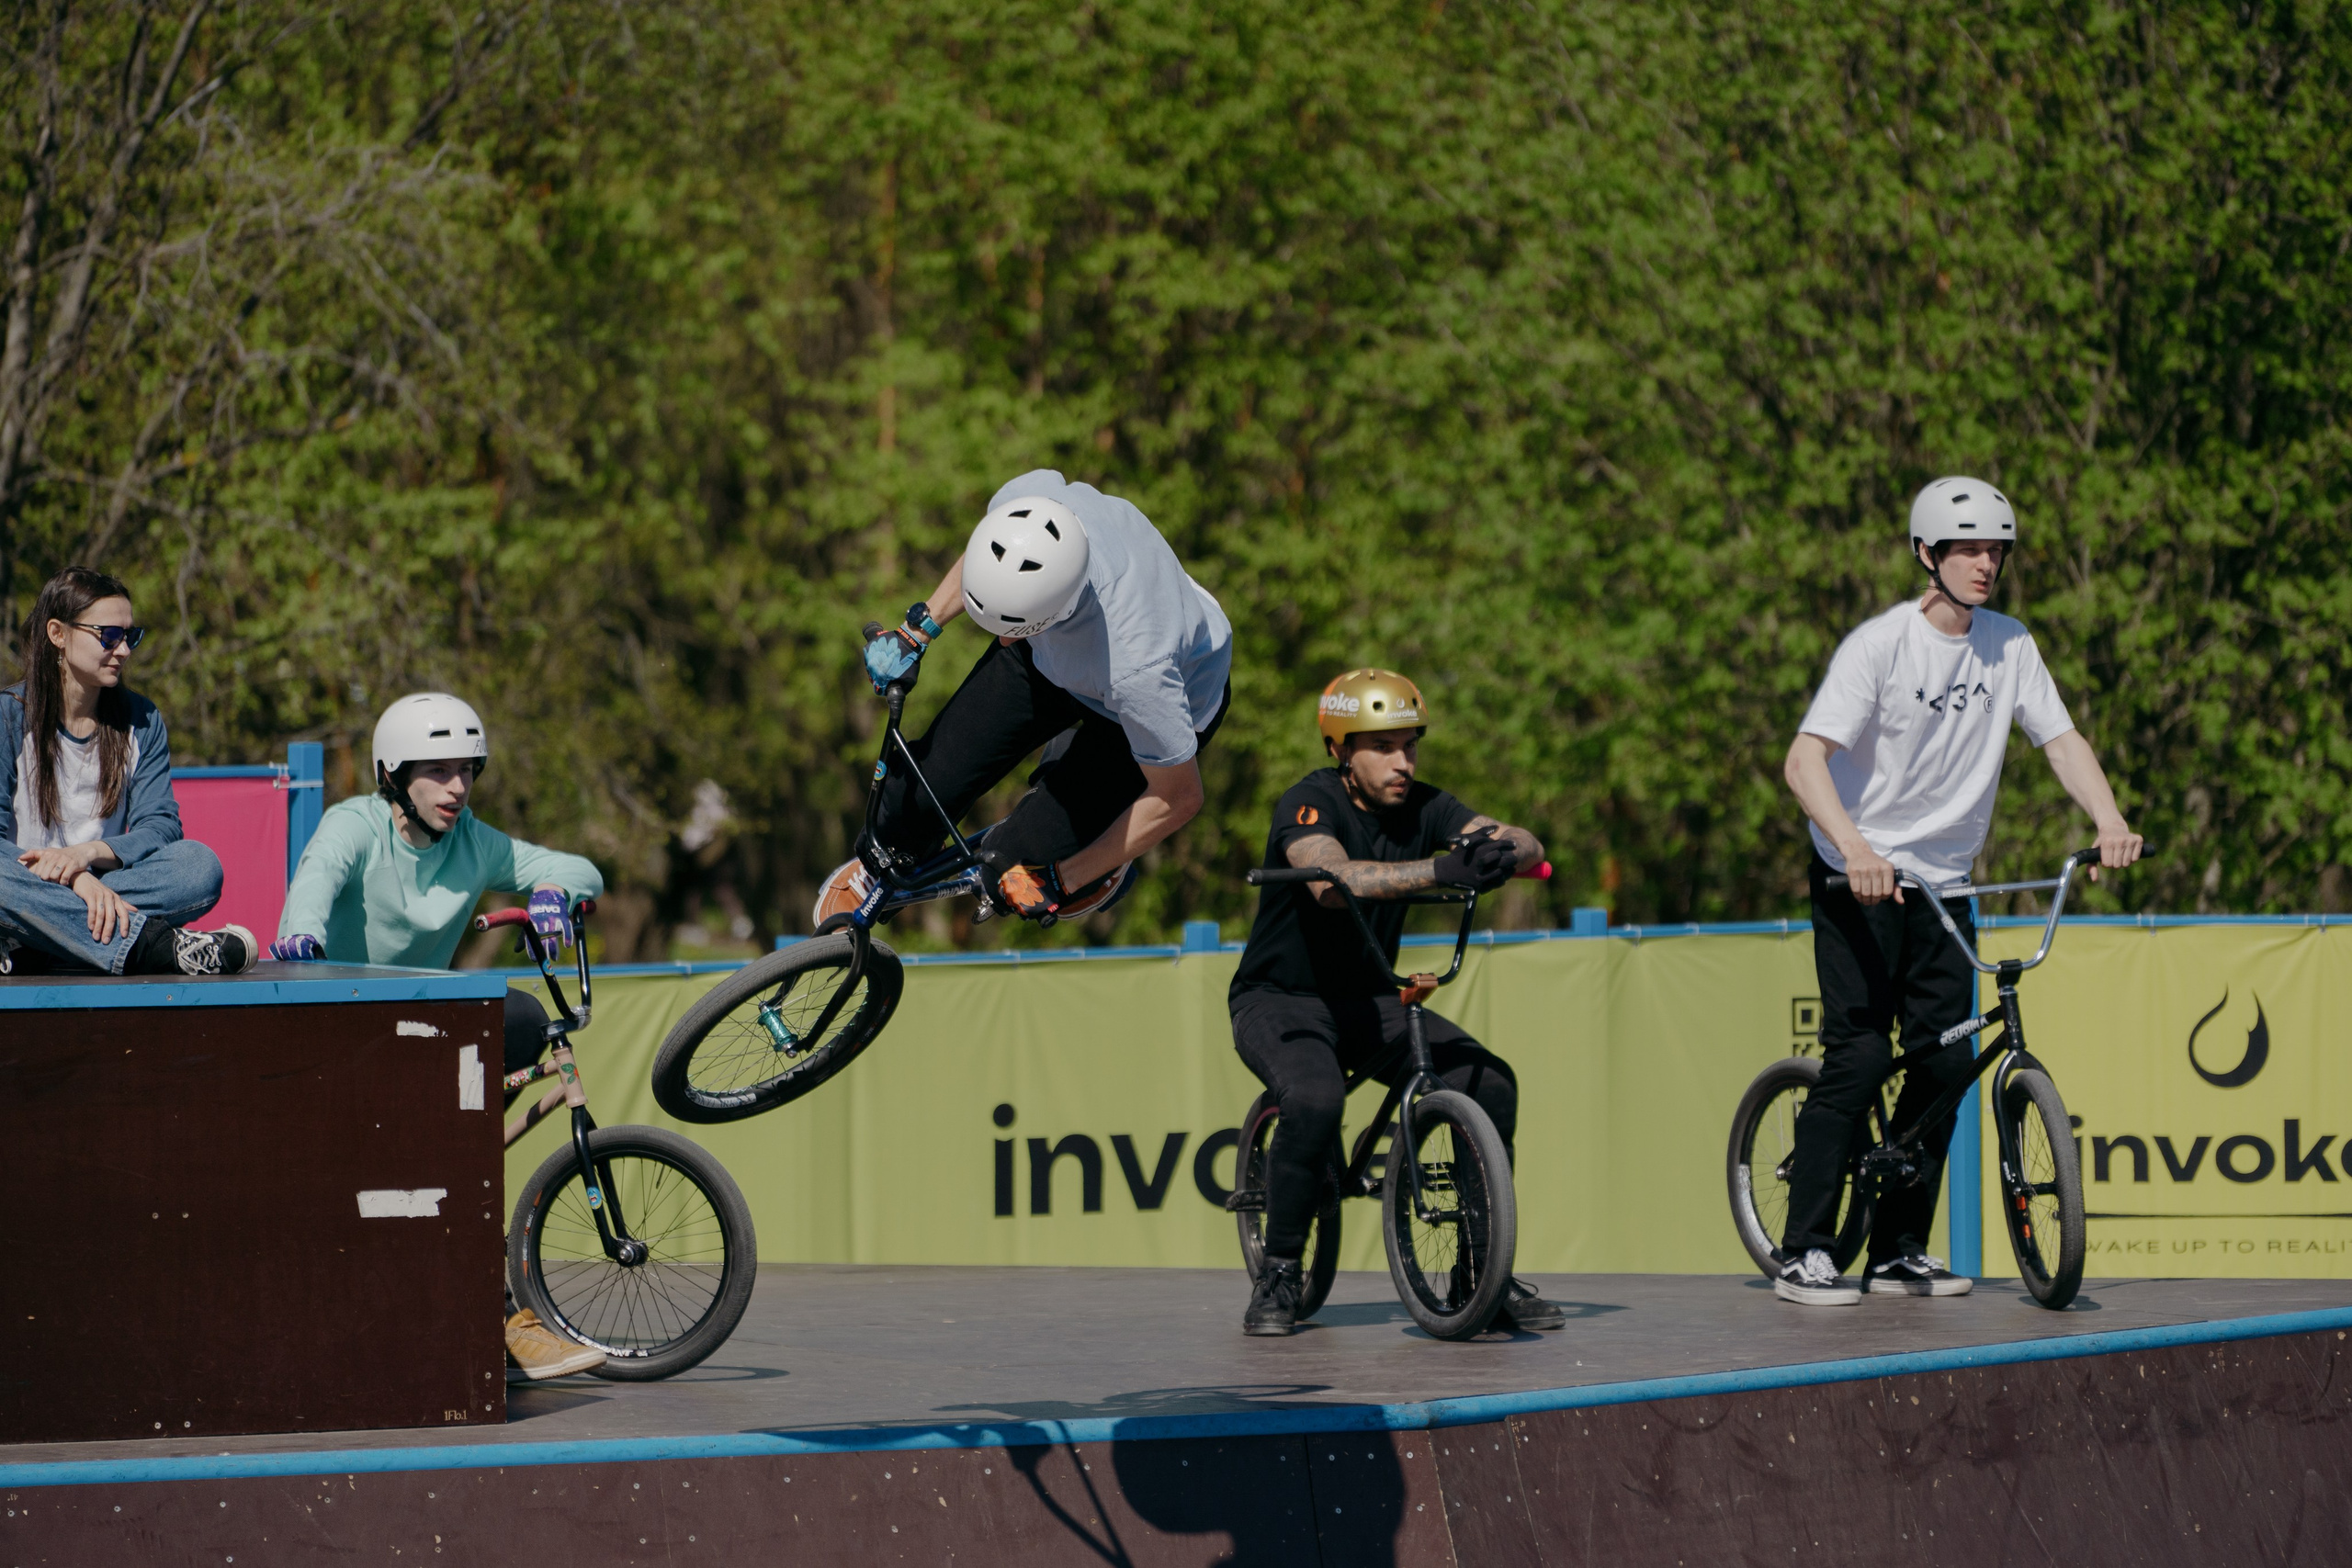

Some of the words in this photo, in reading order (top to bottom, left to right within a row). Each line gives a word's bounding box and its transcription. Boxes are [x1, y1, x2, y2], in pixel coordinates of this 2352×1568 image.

[1003, 616, 1051, 636] FUSE
[937, 883, 973, 900] invoke
[1941, 886, 1977, 898] REDBMX
[859, 886, 885, 918] invoke
[2171, 1238, 2207, 1254] UP
[2219, 1238, 2255, 1254] TO
